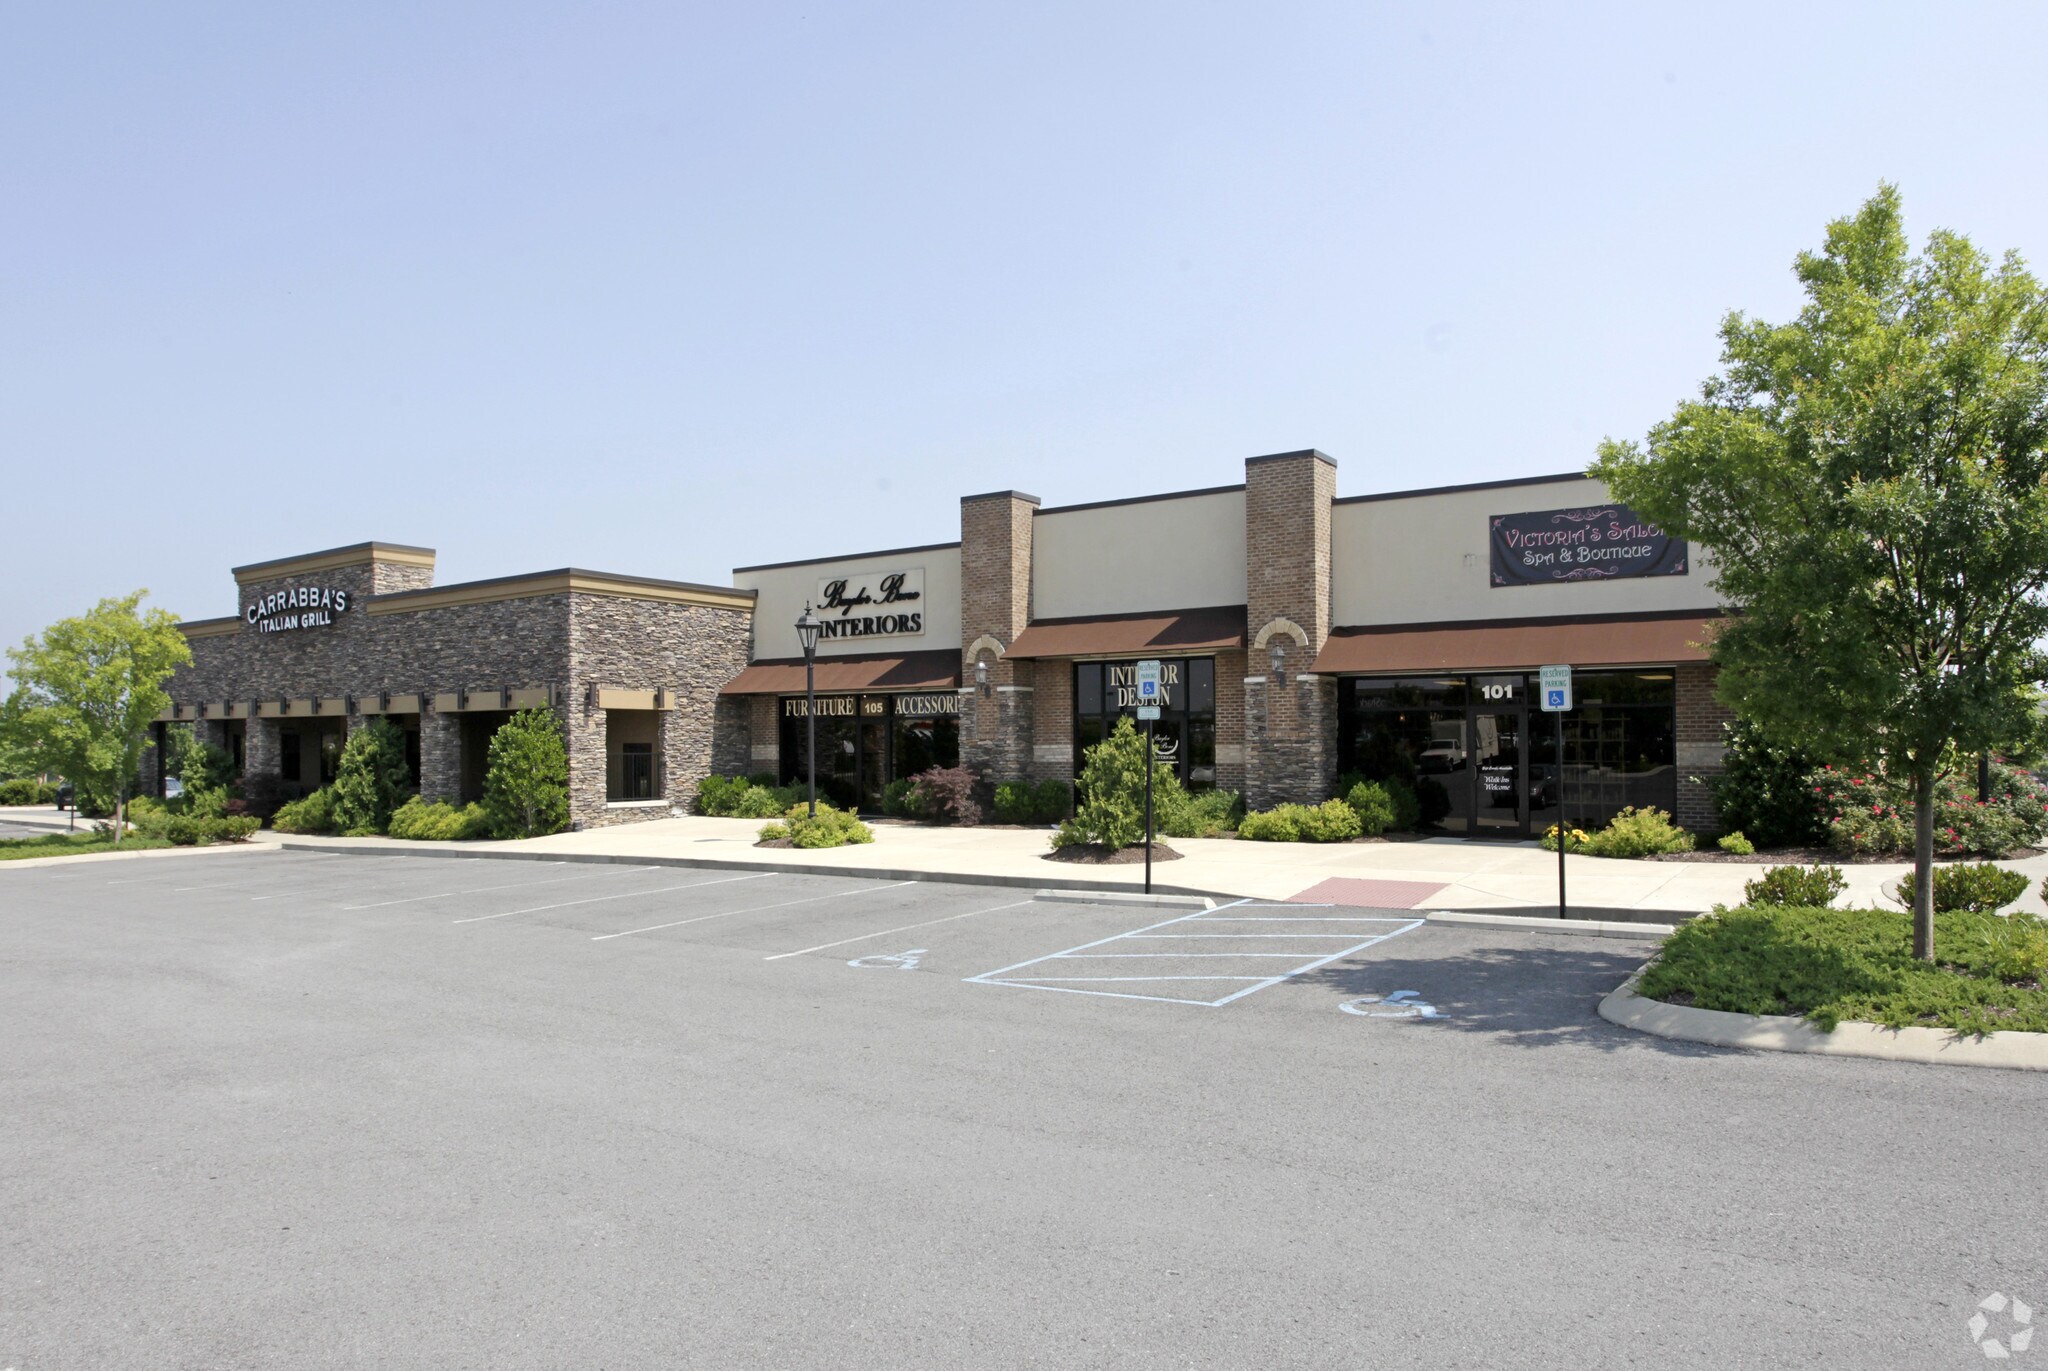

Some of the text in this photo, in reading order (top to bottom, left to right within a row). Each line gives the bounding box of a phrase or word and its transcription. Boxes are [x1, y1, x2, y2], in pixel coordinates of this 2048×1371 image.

[1559, 548, 1573, 563] &
[247, 587, 346, 624] CARRABBA'S
[260, 610, 331, 633] ITALIAN GRILL
[818, 613, 922, 638] INTERIORS
[1110, 664, 1179, 686] INTOR
[1542, 670, 1569, 678] RESERVED
[1481, 684, 1513, 699] 101
[864, 702, 884, 714] 105
[895, 695, 958, 715] ACCESSORI
